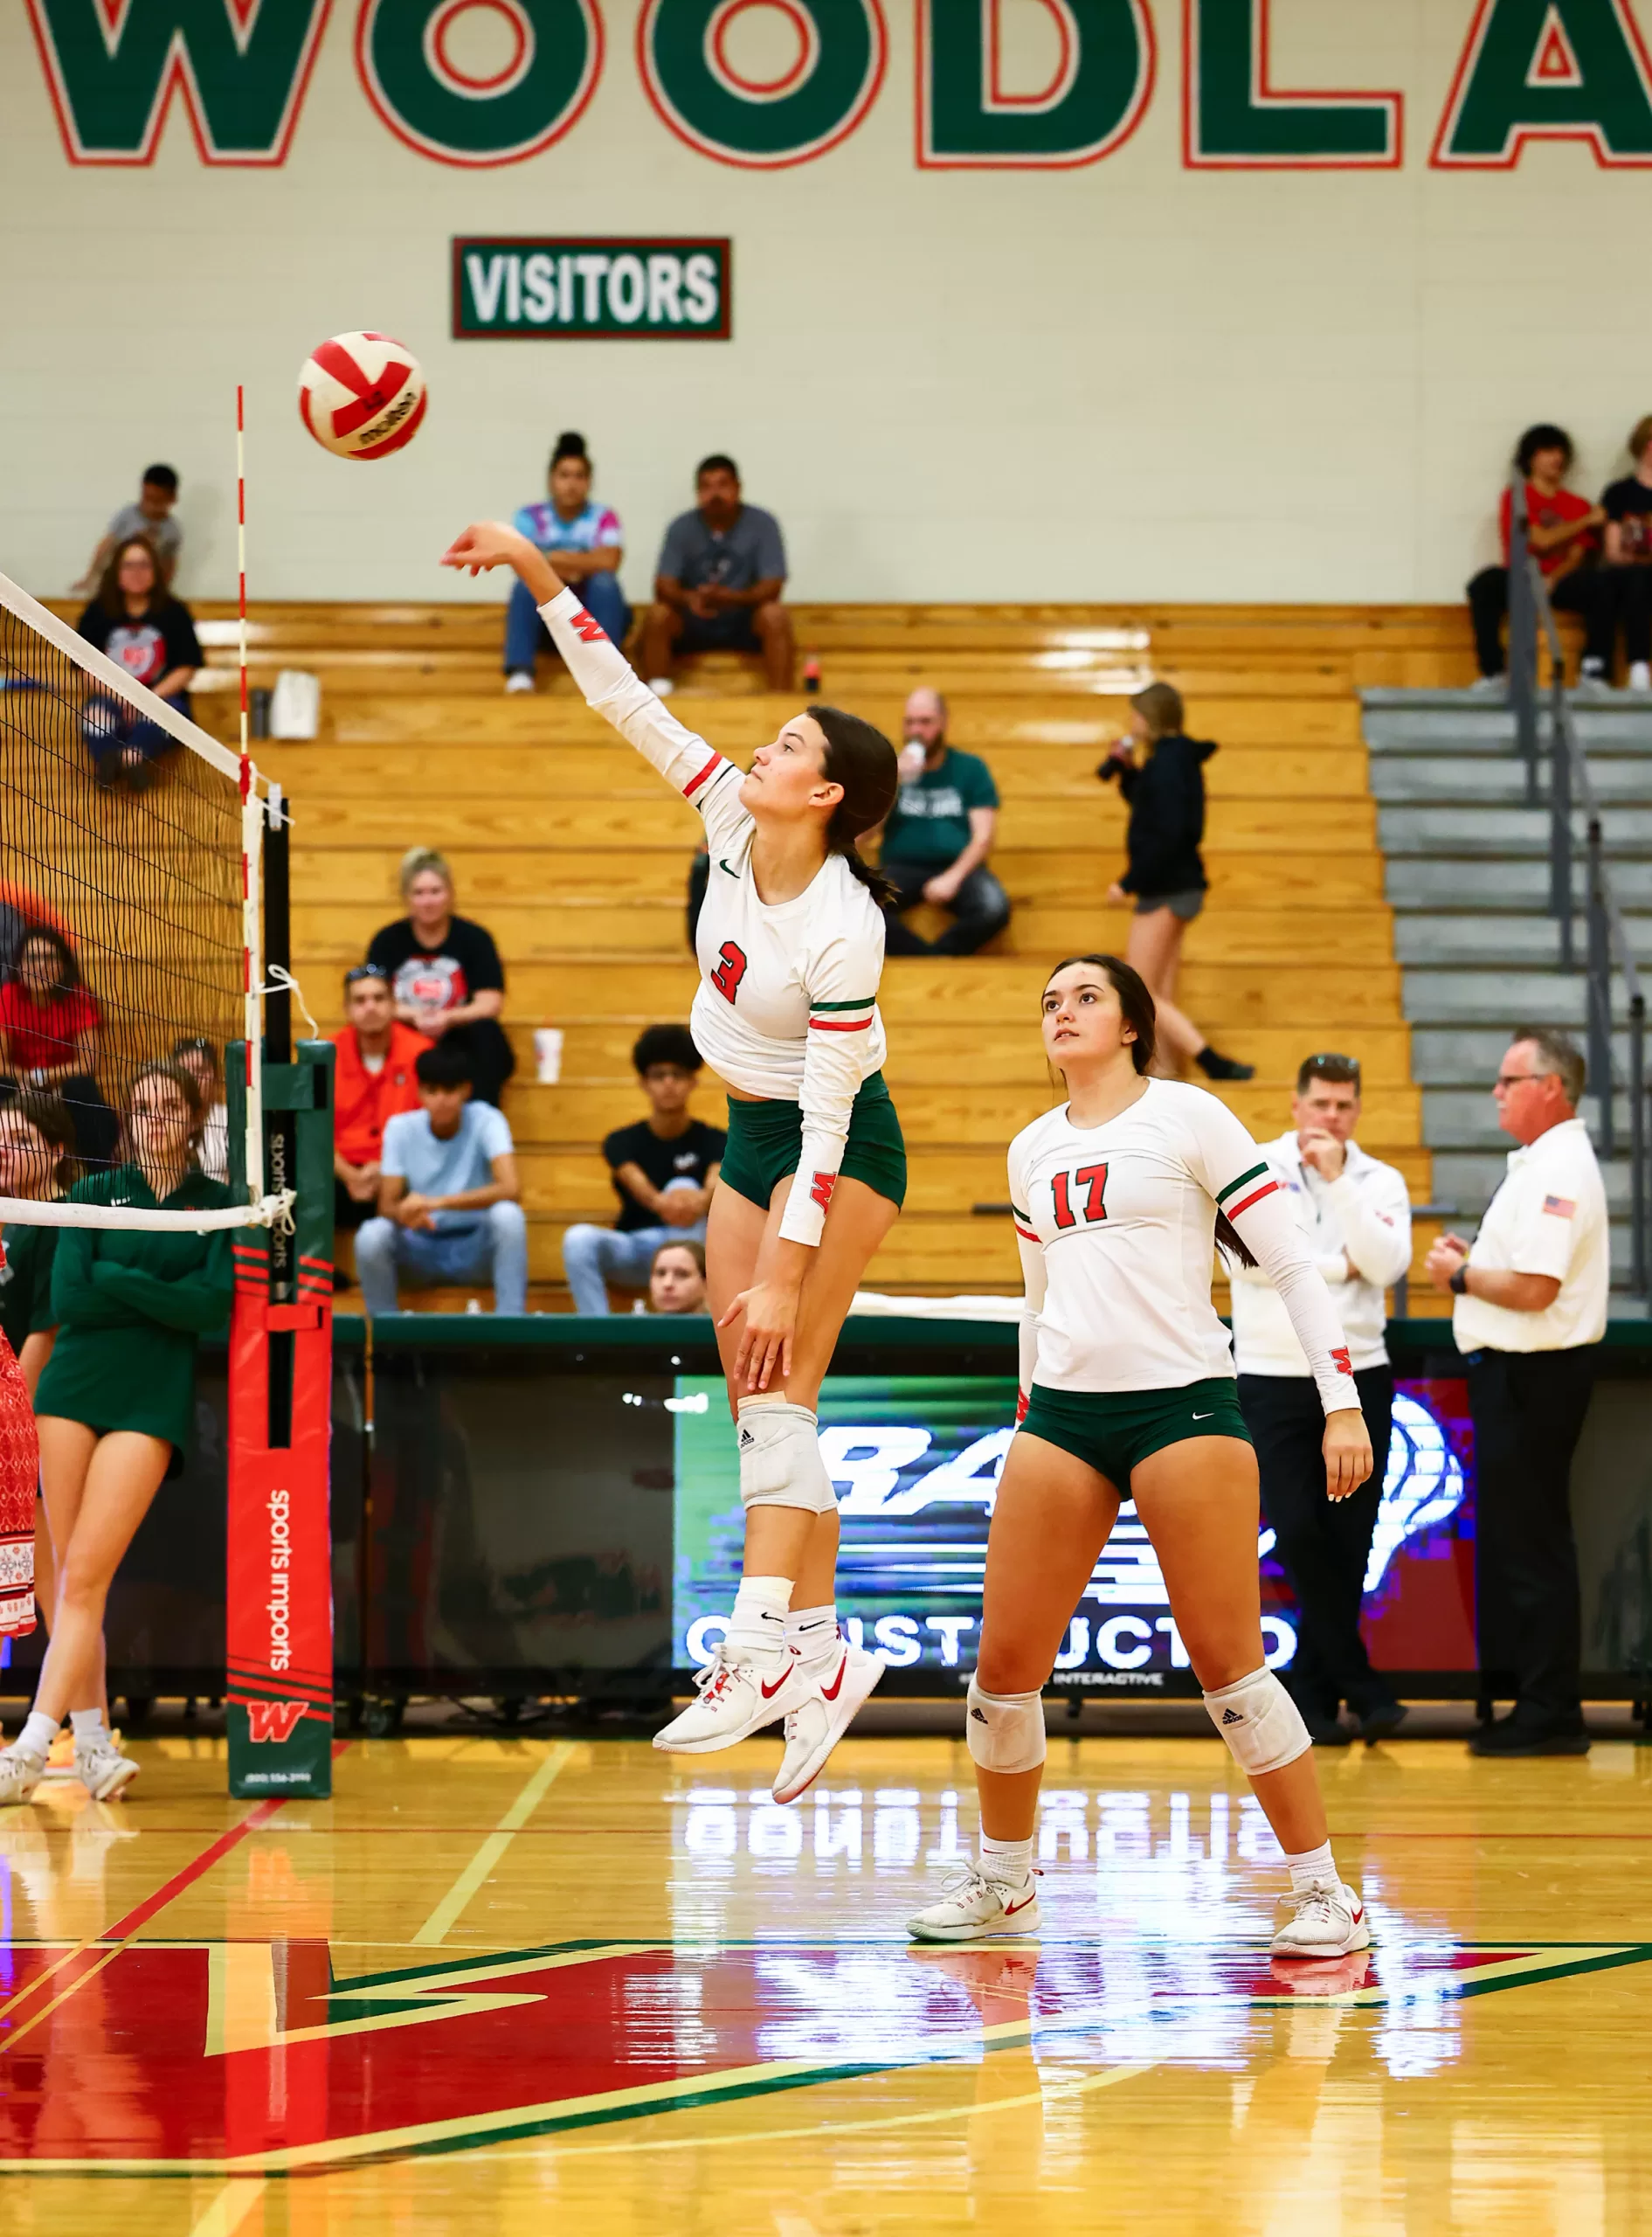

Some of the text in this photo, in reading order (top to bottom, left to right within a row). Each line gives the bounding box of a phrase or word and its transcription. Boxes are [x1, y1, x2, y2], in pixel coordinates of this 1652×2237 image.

[26, 0, 1652, 170] WOODLA
[466, 254, 718, 322] VISITORS
[710, 940, 747, 1006] 3
[1051, 1162, 1109, 1229] 17
[266, 1489, 293, 1671] sports imports
[1053, 1672, 1164, 1686] INTERACTIVE
[247, 1700, 310, 1743] W
